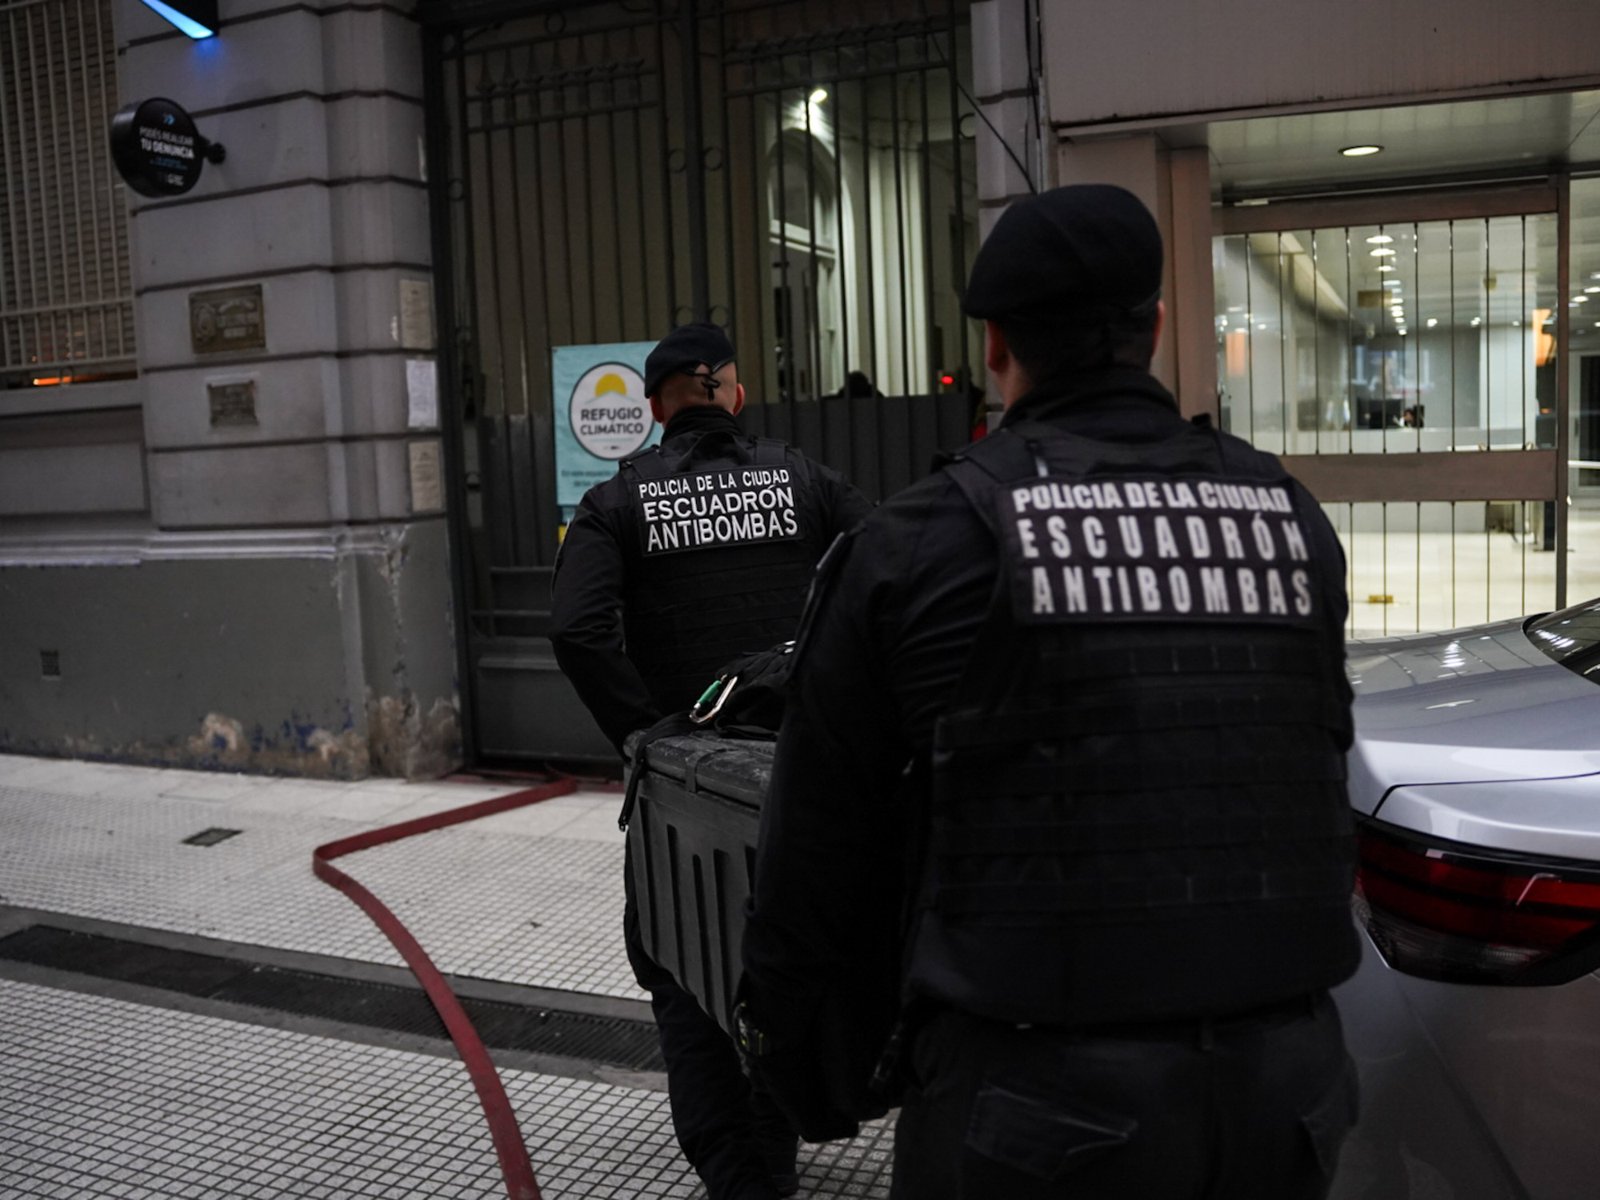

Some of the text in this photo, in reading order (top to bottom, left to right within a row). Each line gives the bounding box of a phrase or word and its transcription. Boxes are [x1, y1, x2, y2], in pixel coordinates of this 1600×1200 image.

[141, 137, 194, 159] TU DENUNCIA
[580, 420, 644, 435] CLIMÁTICO
[581, 407, 643, 421] REFUGIO
[639, 469, 790, 499] POLICIA DE LA CIUDAD
[1012, 481, 1293, 513] POLICIA DE LA CIUDAD
[643, 484, 794, 522] ESCUADRÓN
[648, 508, 798, 552] ANTIBOMBAS
[1016, 511, 1309, 562] ESCUADRÓN
[1032, 565, 1312, 616] ANTIBOMBAS
